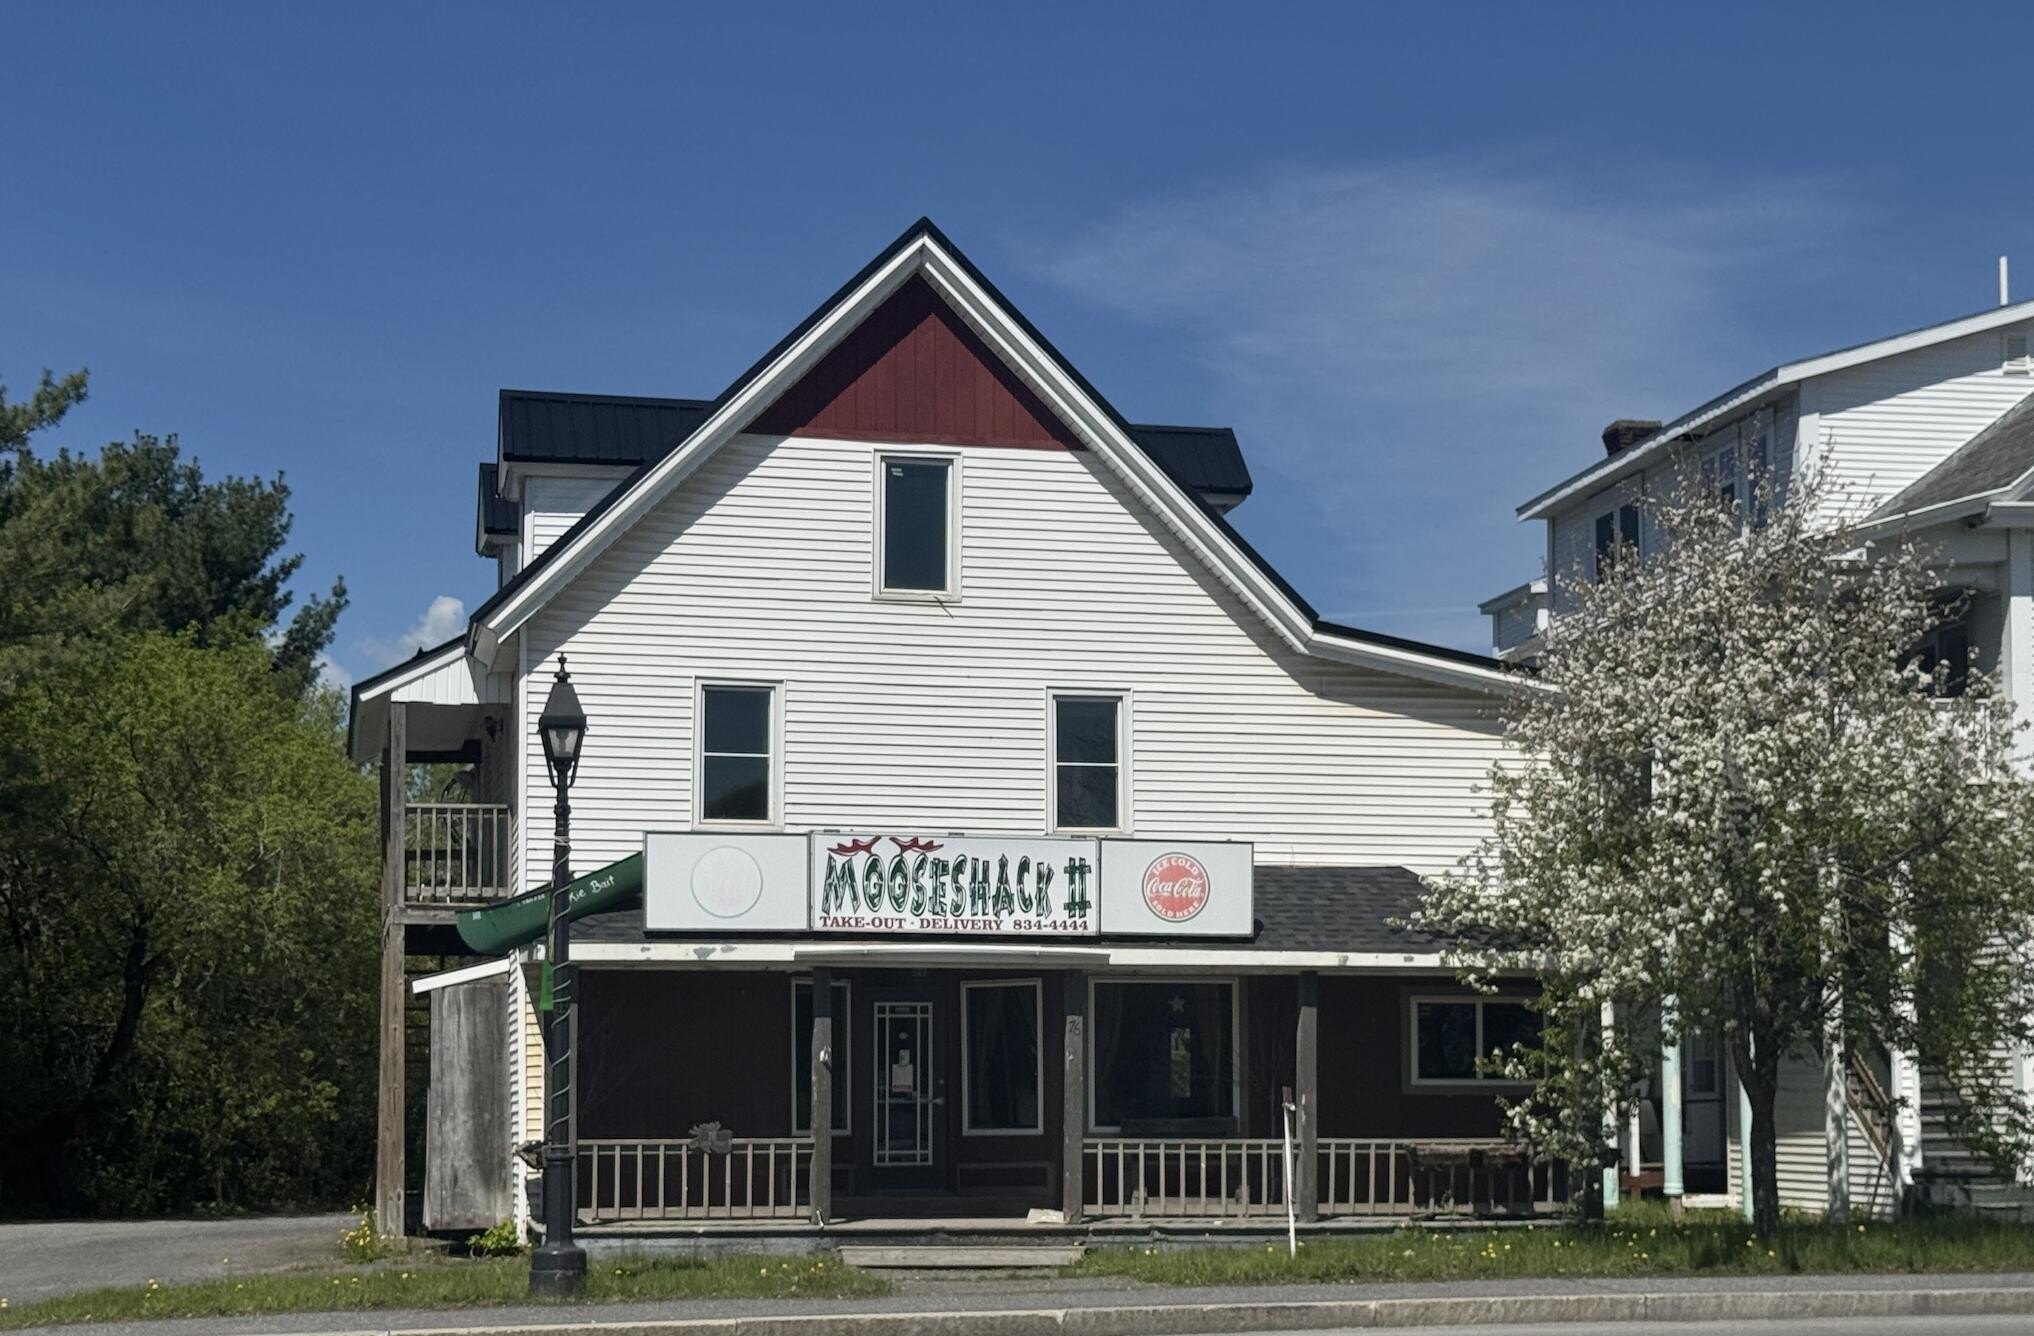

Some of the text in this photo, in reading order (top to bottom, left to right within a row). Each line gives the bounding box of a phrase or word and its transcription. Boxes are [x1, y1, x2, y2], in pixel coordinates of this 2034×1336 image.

[1152, 858, 1199, 876] ICE COLD
[590, 874, 615, 893] Bait
[1146, 877, 1203, 898] Coca-Cola
[1152, 900, 1199, 918] SOLD HERE
[820, 916, 1089, 931] TAKE-OUT DELIVERY 834-4444
